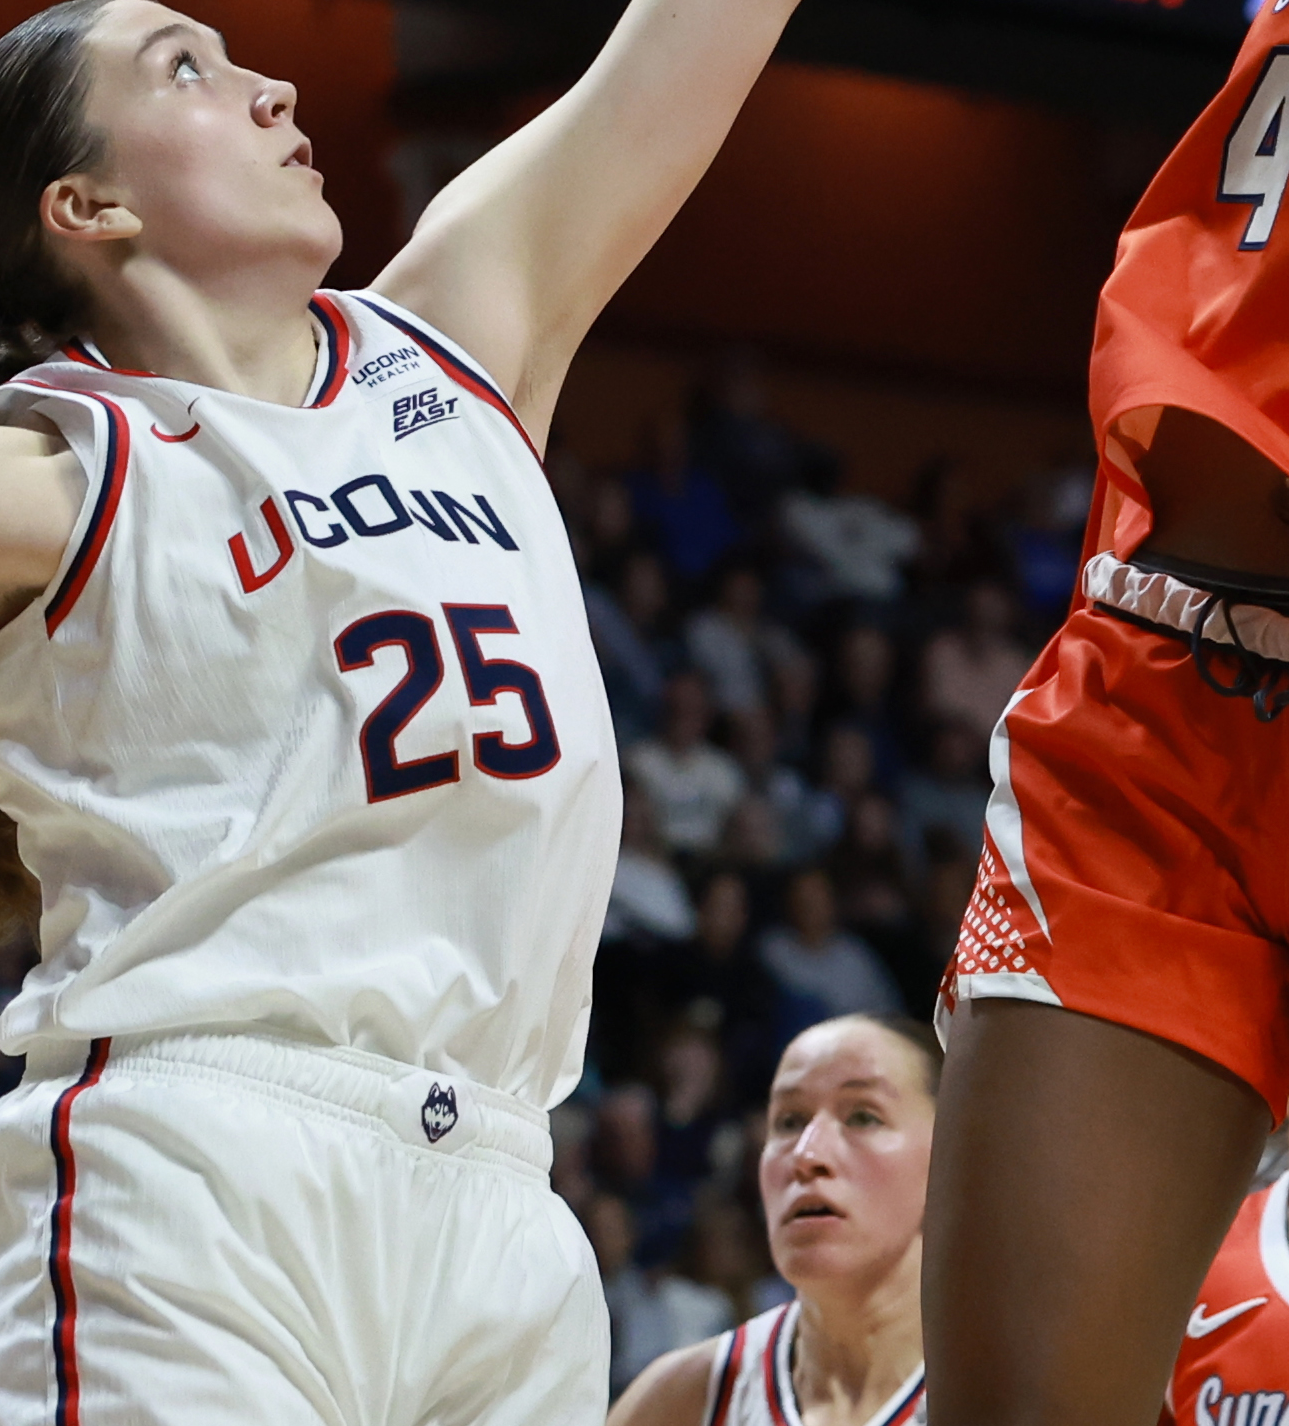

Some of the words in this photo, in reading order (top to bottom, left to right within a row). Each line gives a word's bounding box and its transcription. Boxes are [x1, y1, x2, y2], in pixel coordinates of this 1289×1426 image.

[351, 345, 421, 385] UCONN
[366, 360, 421, 389] HEALTH
[393, 387, 439, 417] BIG
[393, 397, 459, 433] EAST
[227, 474, 521, 595] UCONN
[333, 601, 562, 805] 25
